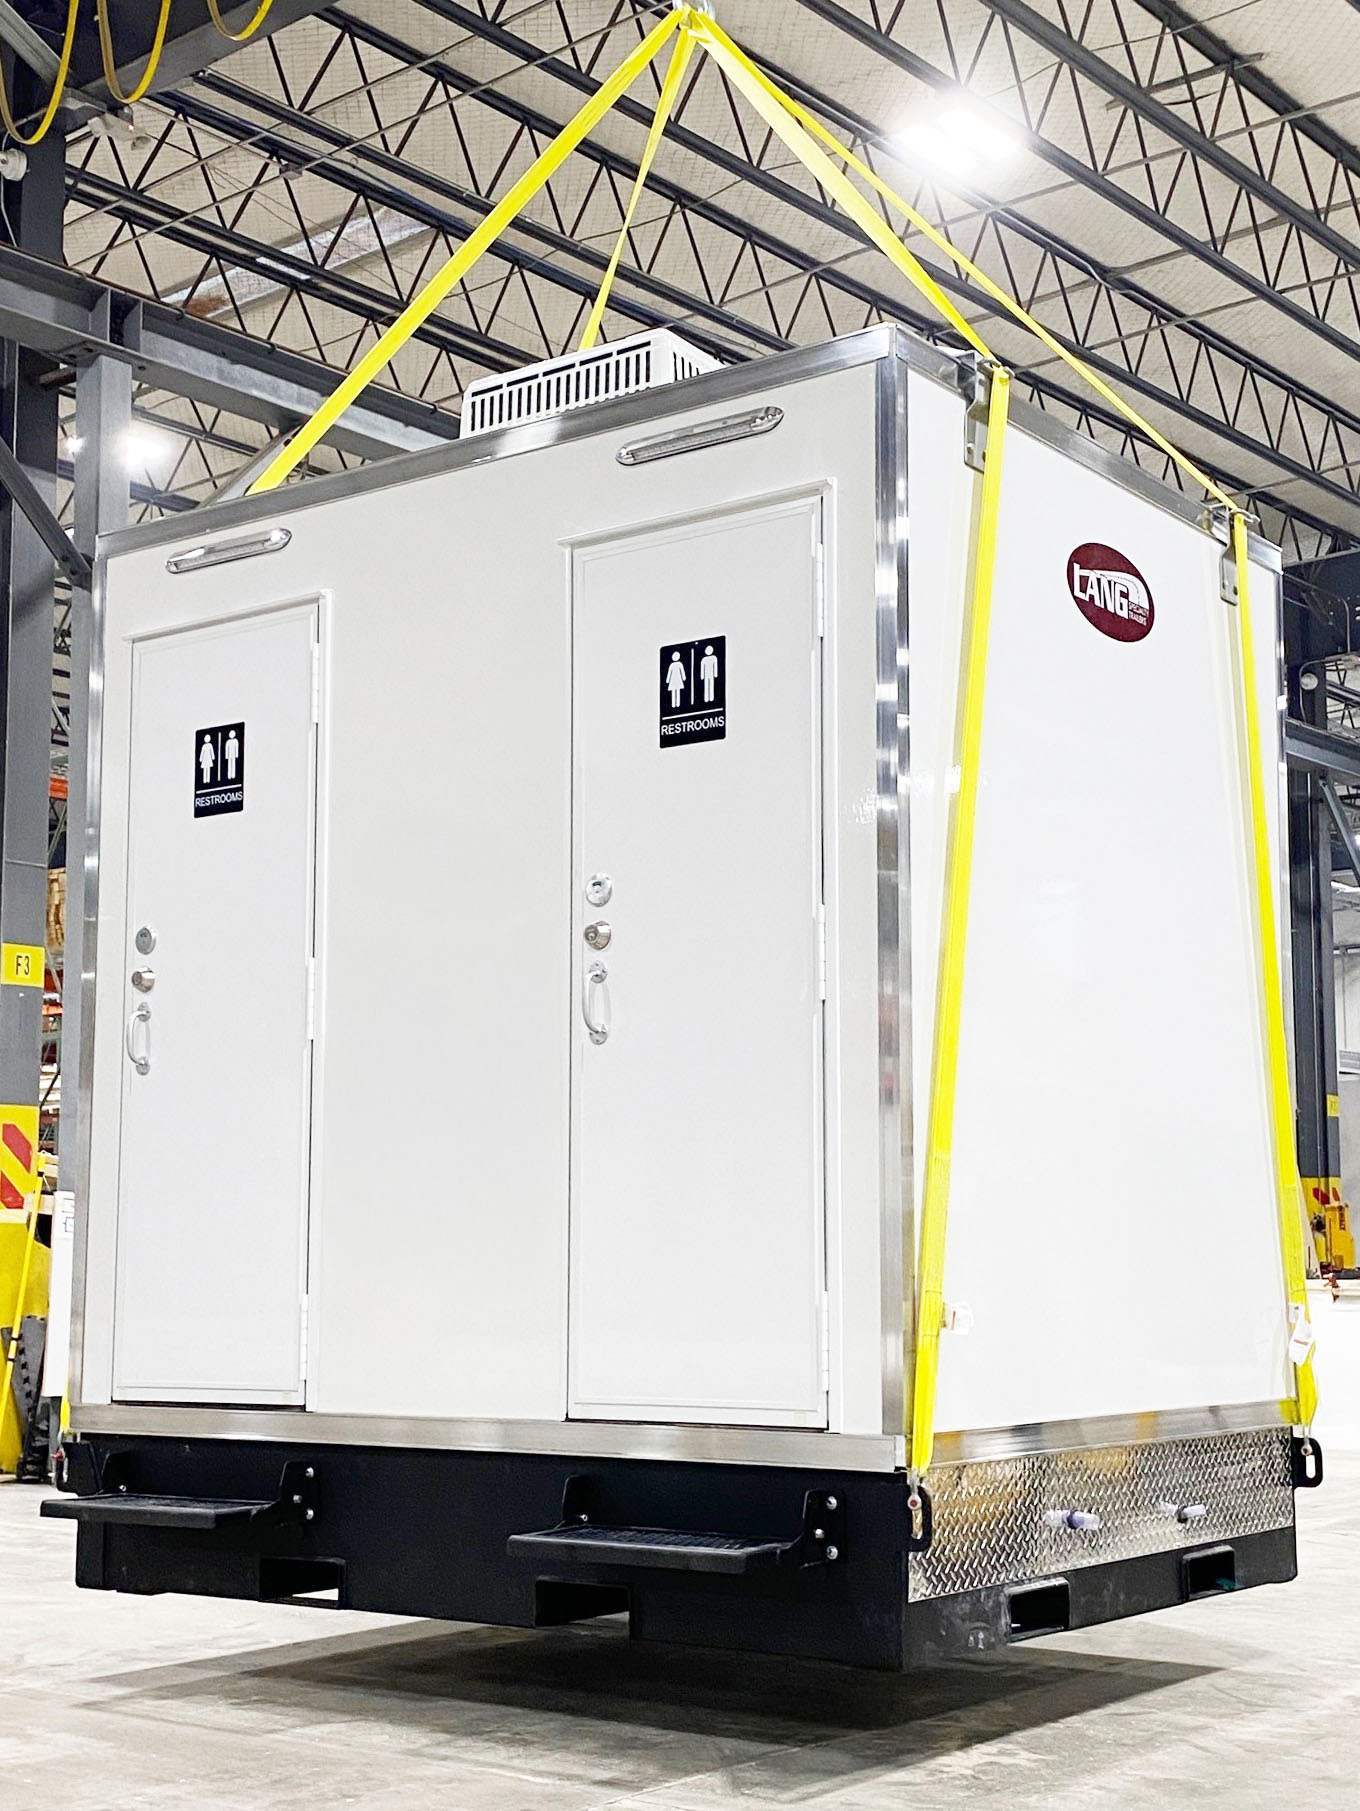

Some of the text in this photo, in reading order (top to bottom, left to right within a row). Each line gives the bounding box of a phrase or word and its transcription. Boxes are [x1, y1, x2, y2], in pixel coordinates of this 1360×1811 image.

[1073, 562, 1129, 620] LANG
[661, 716, 725, 736] RESTROOMS
[195, 791, 243, 807] RESTROOMS
[16, 955, 30, 975] F3
